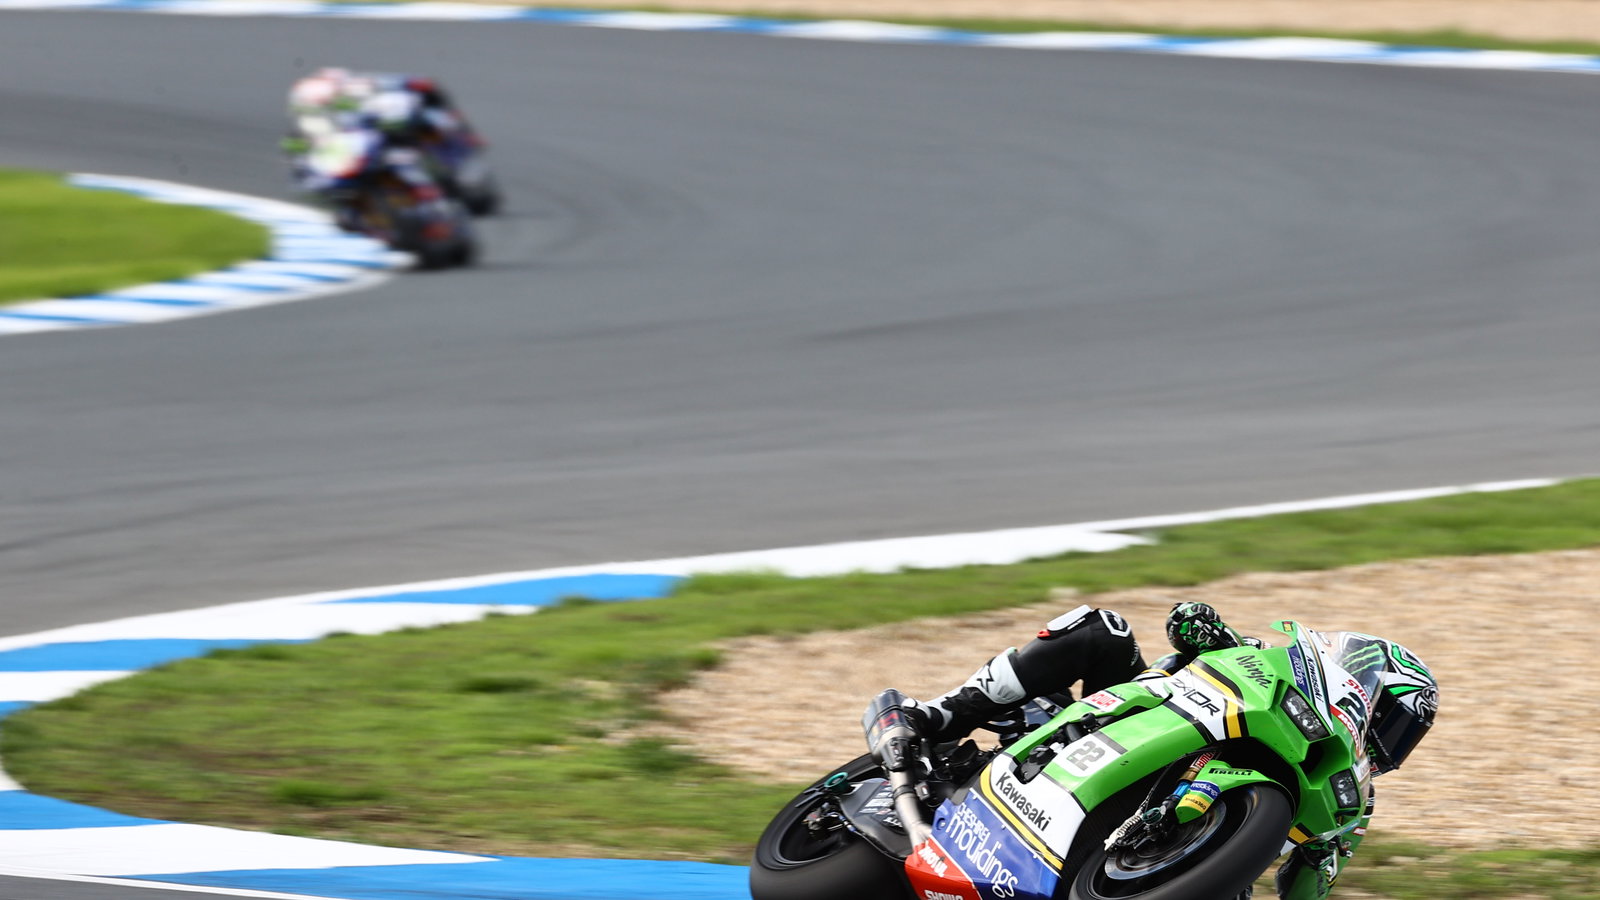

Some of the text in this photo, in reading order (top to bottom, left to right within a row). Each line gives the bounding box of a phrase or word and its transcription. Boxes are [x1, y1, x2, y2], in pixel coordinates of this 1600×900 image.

[1236, 655, 1274, 689] Ninja
[1306, 655, 1324, 703] Kawasaki
[1066, 740, 1106, 771] 22
[1208, 768, 1253, 776] PIRELLI
[995, 771, 1052, 832] Kawasaki
[957, 802, 988, 841] CHESHIRE
[945, 813, 1019, 898] mouldings
